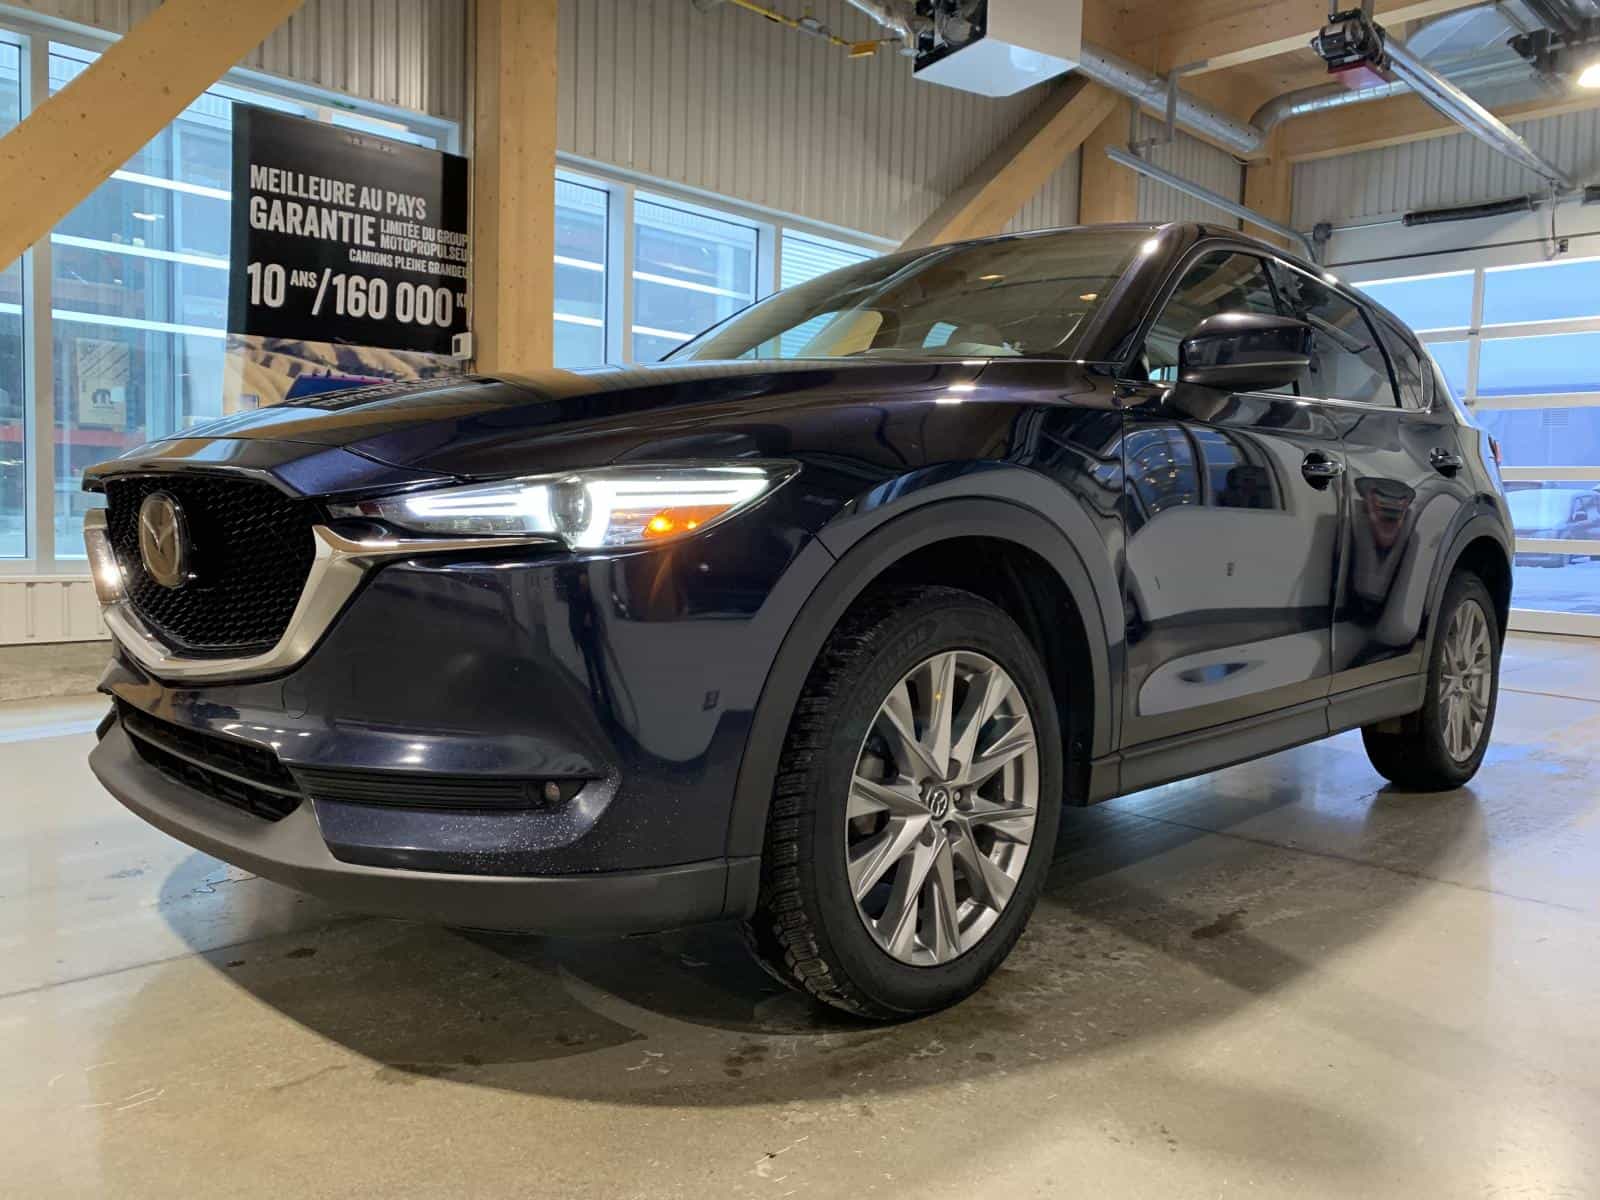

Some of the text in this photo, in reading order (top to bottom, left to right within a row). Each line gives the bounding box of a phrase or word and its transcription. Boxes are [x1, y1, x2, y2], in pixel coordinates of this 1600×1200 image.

[250, 164, 426, 220] MEILLEURE AU PAYS
[250, 195, 376, 247] GARANTIE
[381, 218, 421, 239] LIMITÉE
[422, 225, 436, 242] DU
[349, 248, 393, 268] CAMIONS
[394, 255, 428, 273] PLEINE
[247, 261, 286, 308] 10
[290, 269, 318, 289] ANS
[395, 281, 452, 328] 000
